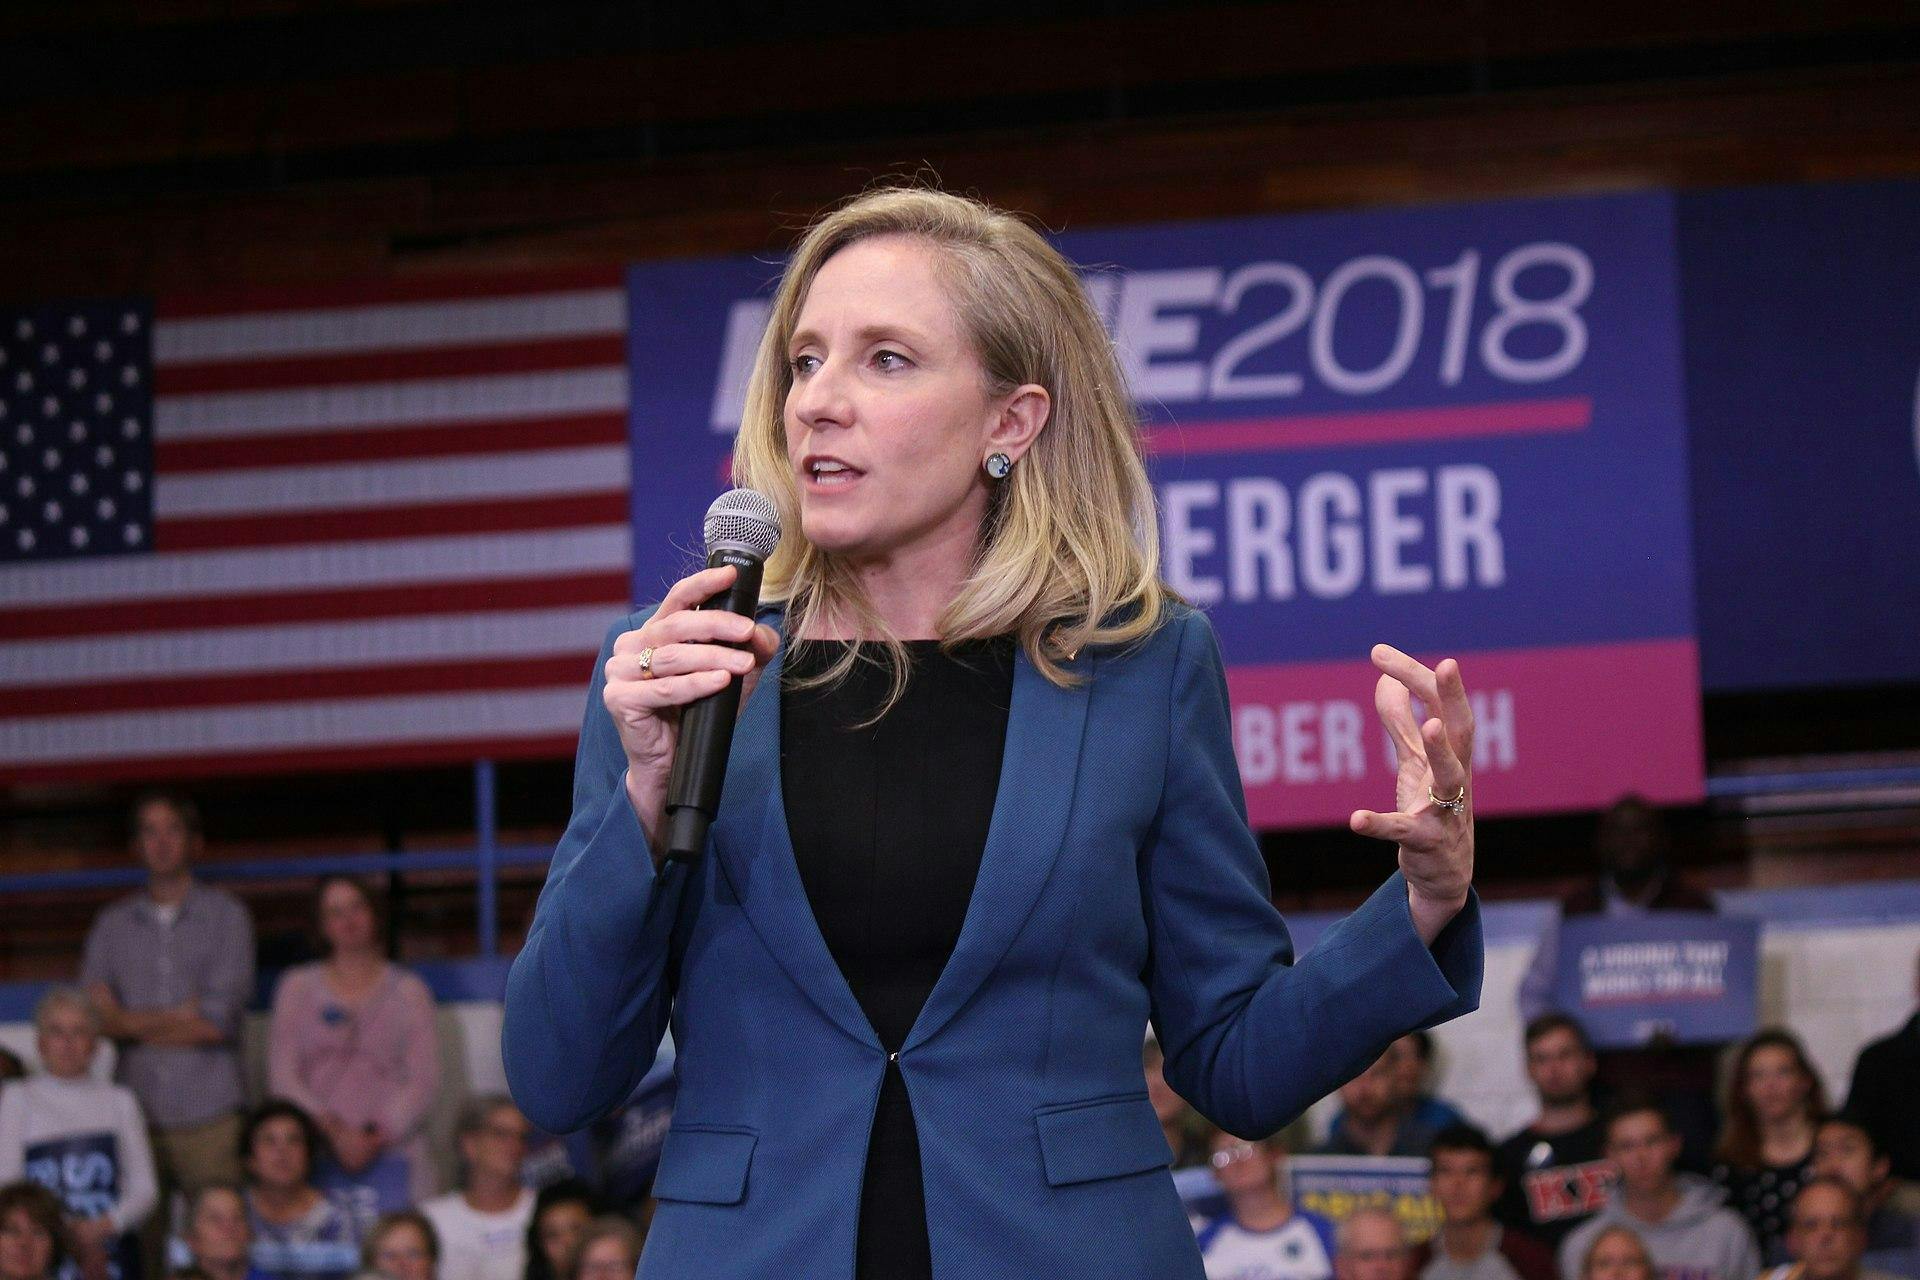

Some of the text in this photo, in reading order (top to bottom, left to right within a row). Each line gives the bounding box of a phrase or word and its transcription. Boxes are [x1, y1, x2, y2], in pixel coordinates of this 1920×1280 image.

[1085, 242, 1595, 402] E2018
[1163, 464, 1504, 603] ERGER
[1237, 699, 1367, 786] BER
